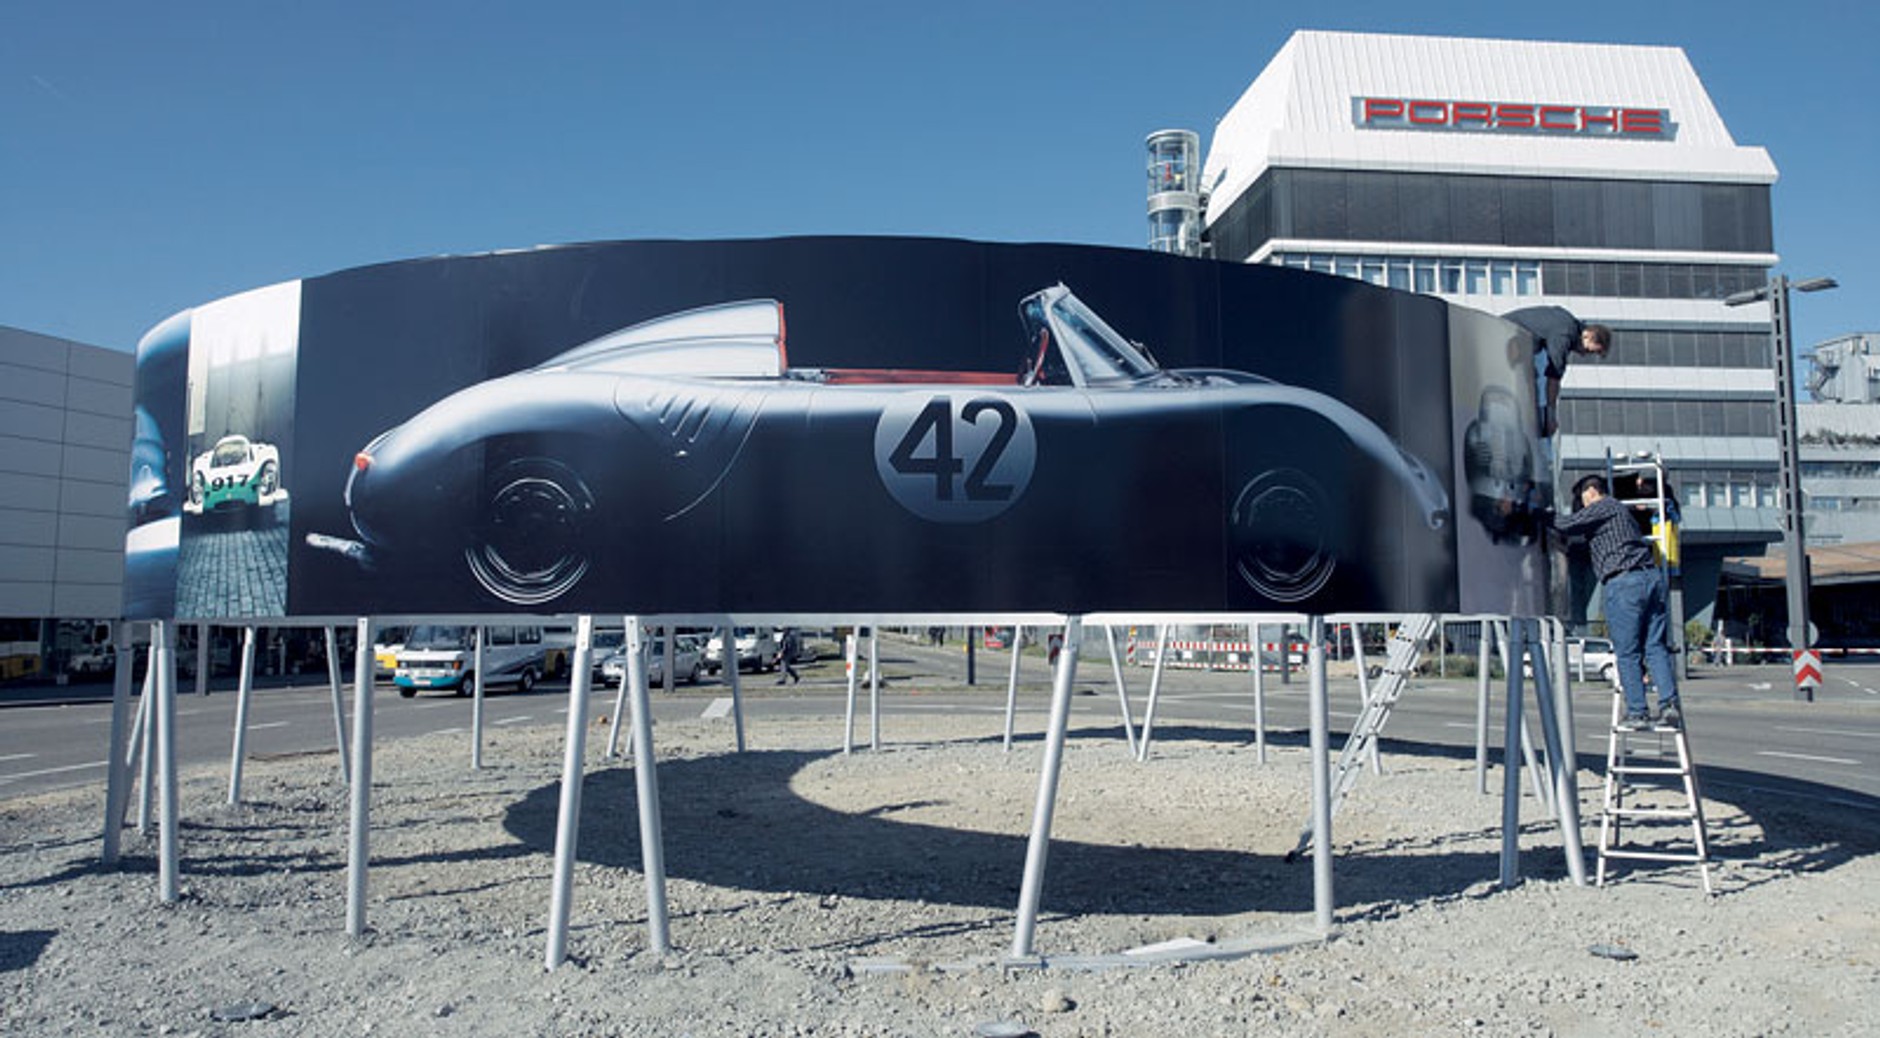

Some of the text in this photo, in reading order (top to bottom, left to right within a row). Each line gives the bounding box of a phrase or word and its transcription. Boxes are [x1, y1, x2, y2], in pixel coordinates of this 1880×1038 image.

[1364, 98, 1661, 133] PORSCHE
[888, 395, 1018, 501] 42
[211, 474, 249, 491] 917
